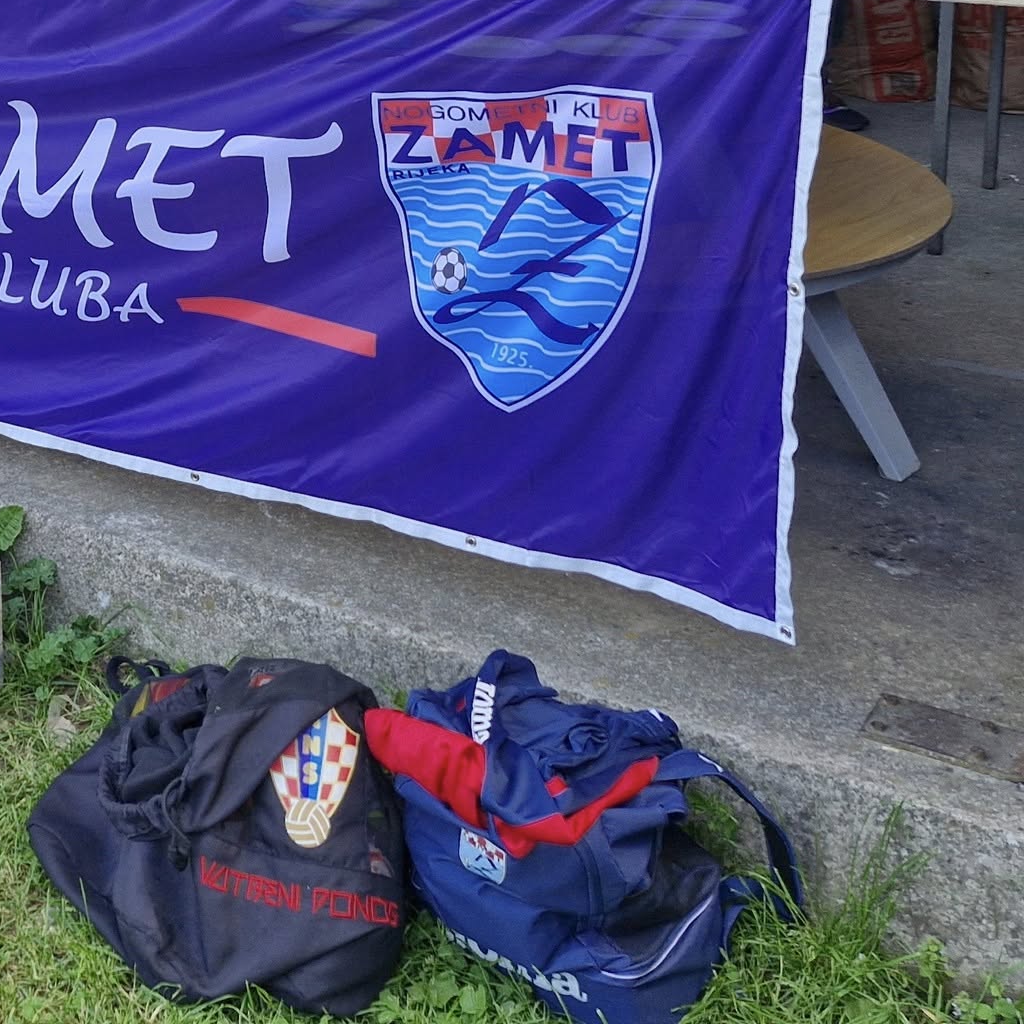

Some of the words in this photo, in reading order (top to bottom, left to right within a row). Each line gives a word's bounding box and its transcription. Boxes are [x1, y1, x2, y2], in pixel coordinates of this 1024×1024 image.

[574, 101, 639, 123] KLUB
[390, 120, 640, 172] ZAMET
[392, 162, 471, 180] RIJEKA
